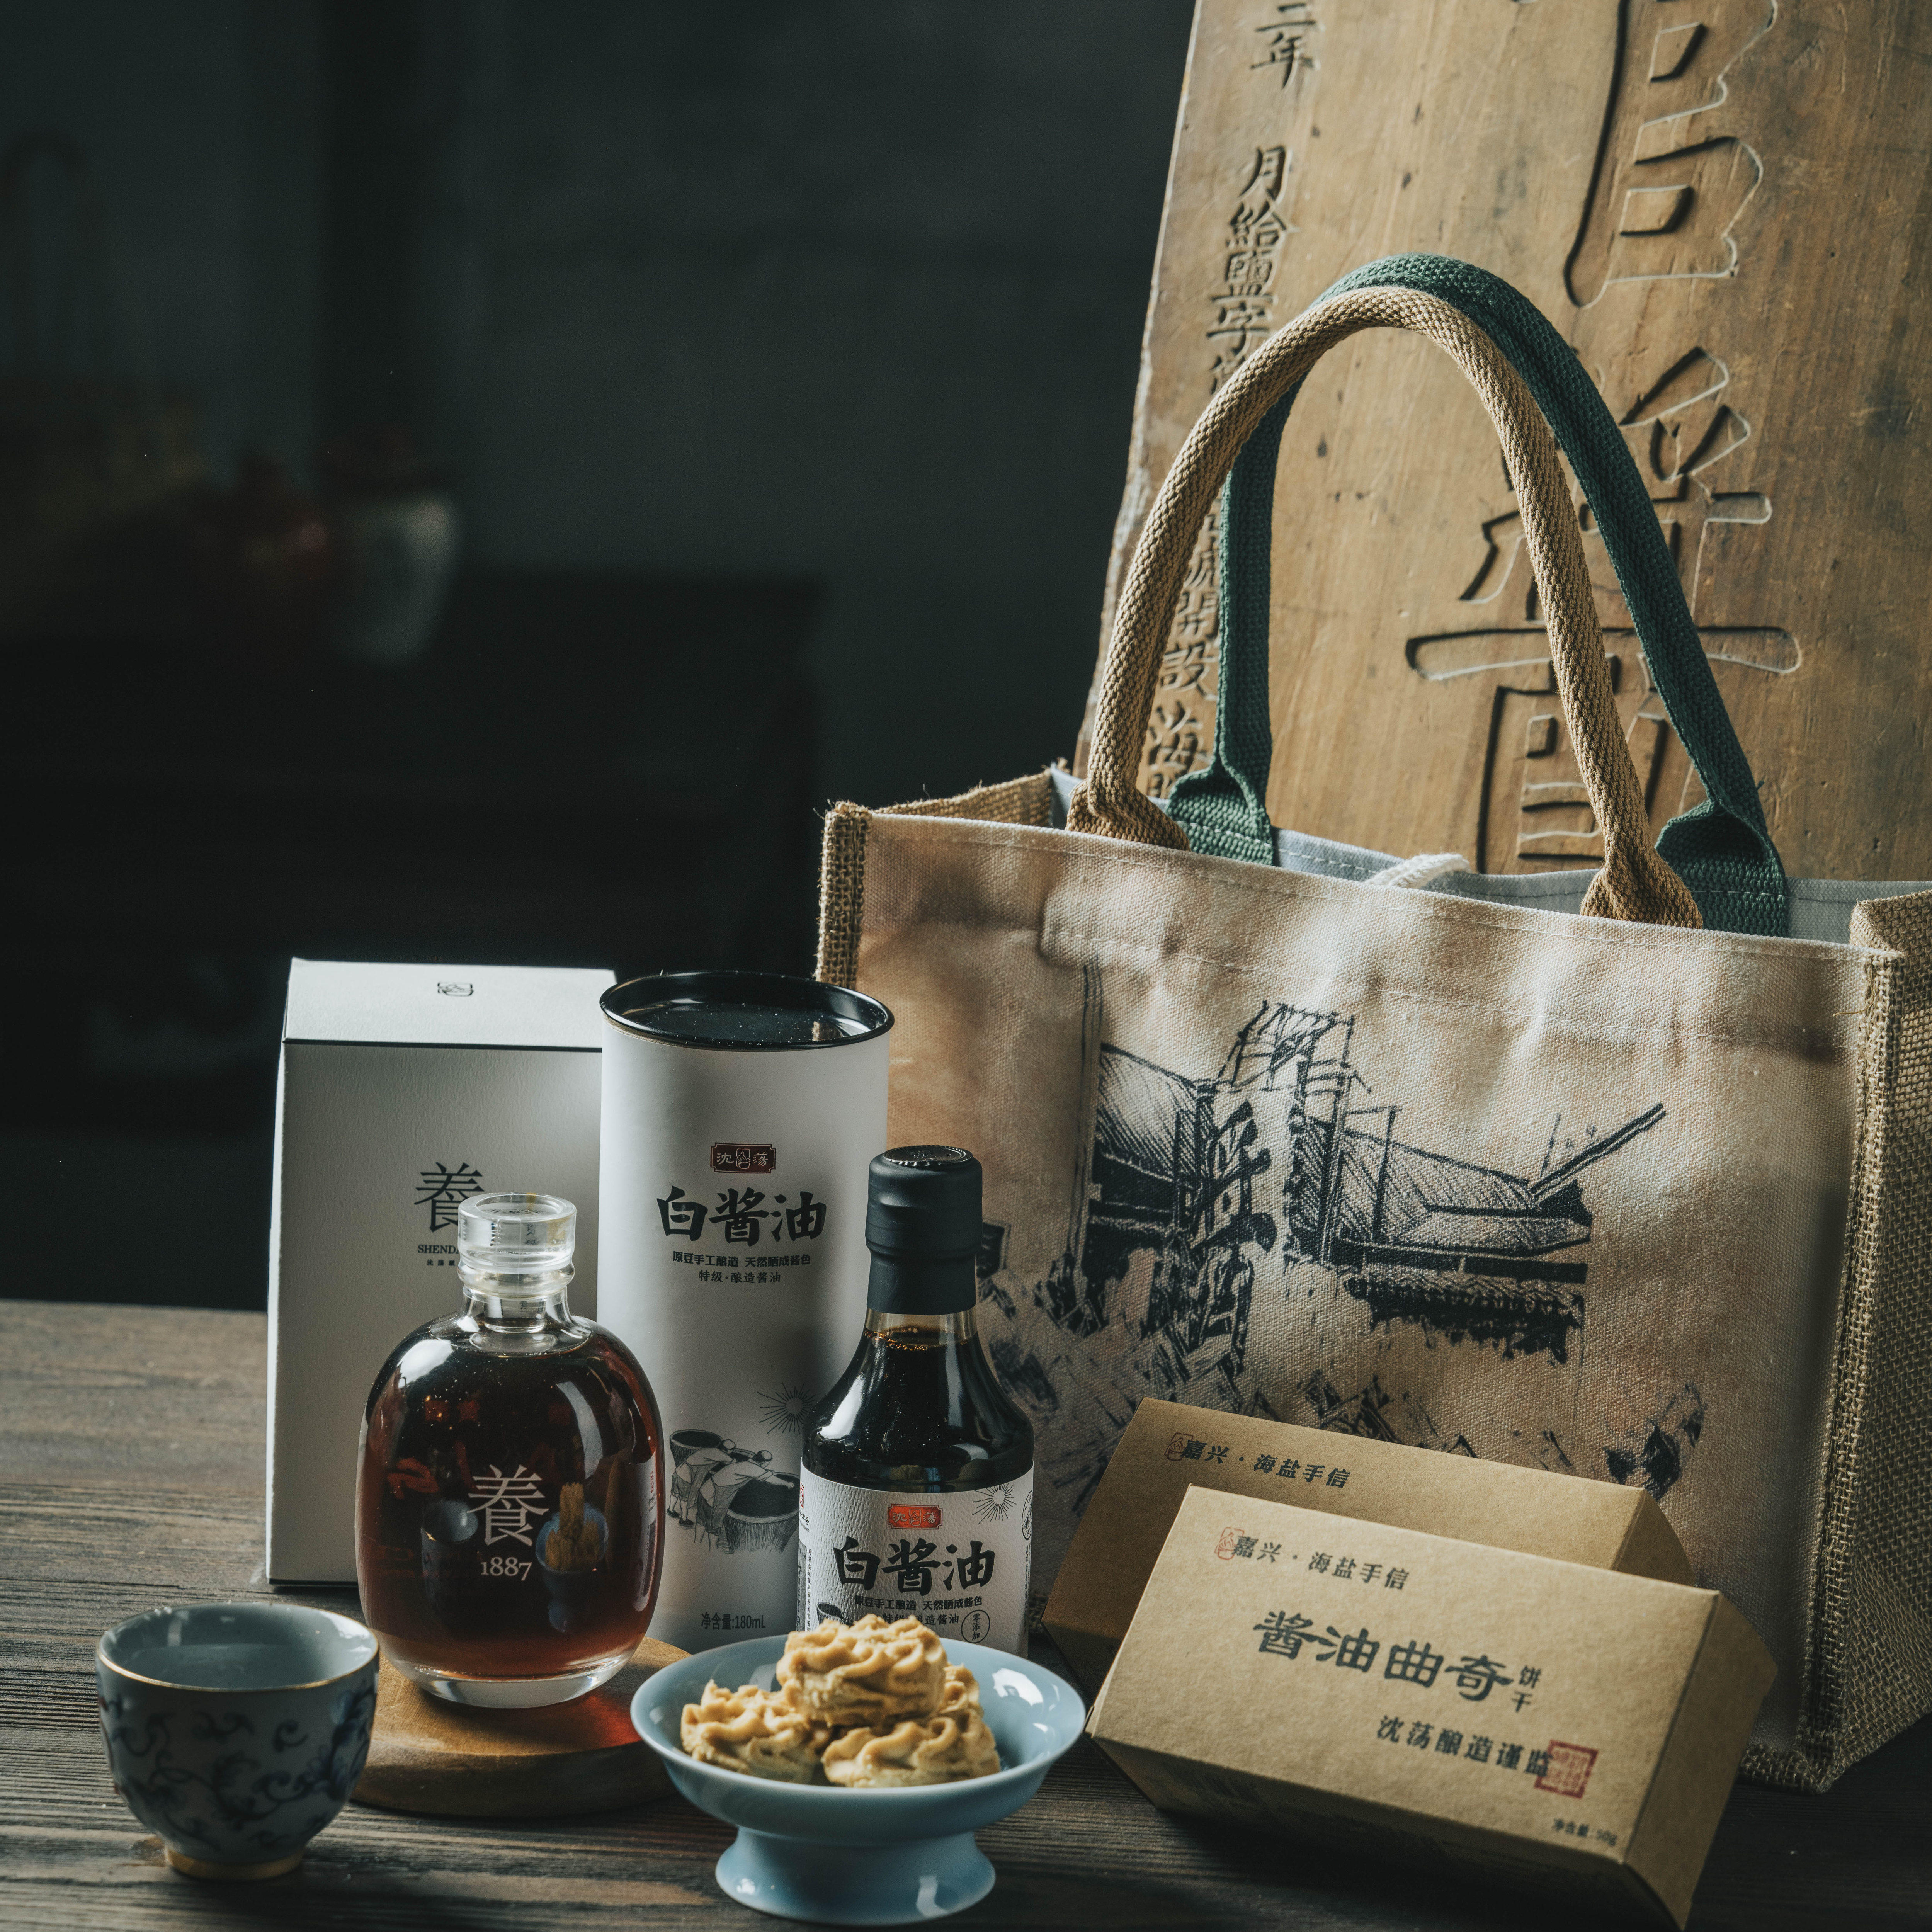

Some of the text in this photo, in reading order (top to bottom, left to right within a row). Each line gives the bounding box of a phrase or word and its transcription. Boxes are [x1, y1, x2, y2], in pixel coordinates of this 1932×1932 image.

[657, 1185, 827, 1247] 白酱油
[418, 1244, 460, 1254] SHEND
[673, 1251, 811, 1268] 原豆手工酿造 天然晒成酱色
[466, 1464, 549, 1546] 養
[480, 1556, 532, 1581] 1887
[833, 1536, 995, 1596] 白酱油
[855, 1595, 983, 1611] 原豆手工酿造 天然晒成酱色
[971, 1613, 981, 1641] 零添加
[1253, 1610, 1514, 1702] 酱油曲奇
[1510, 1665, 1541, 1713] 饼干
